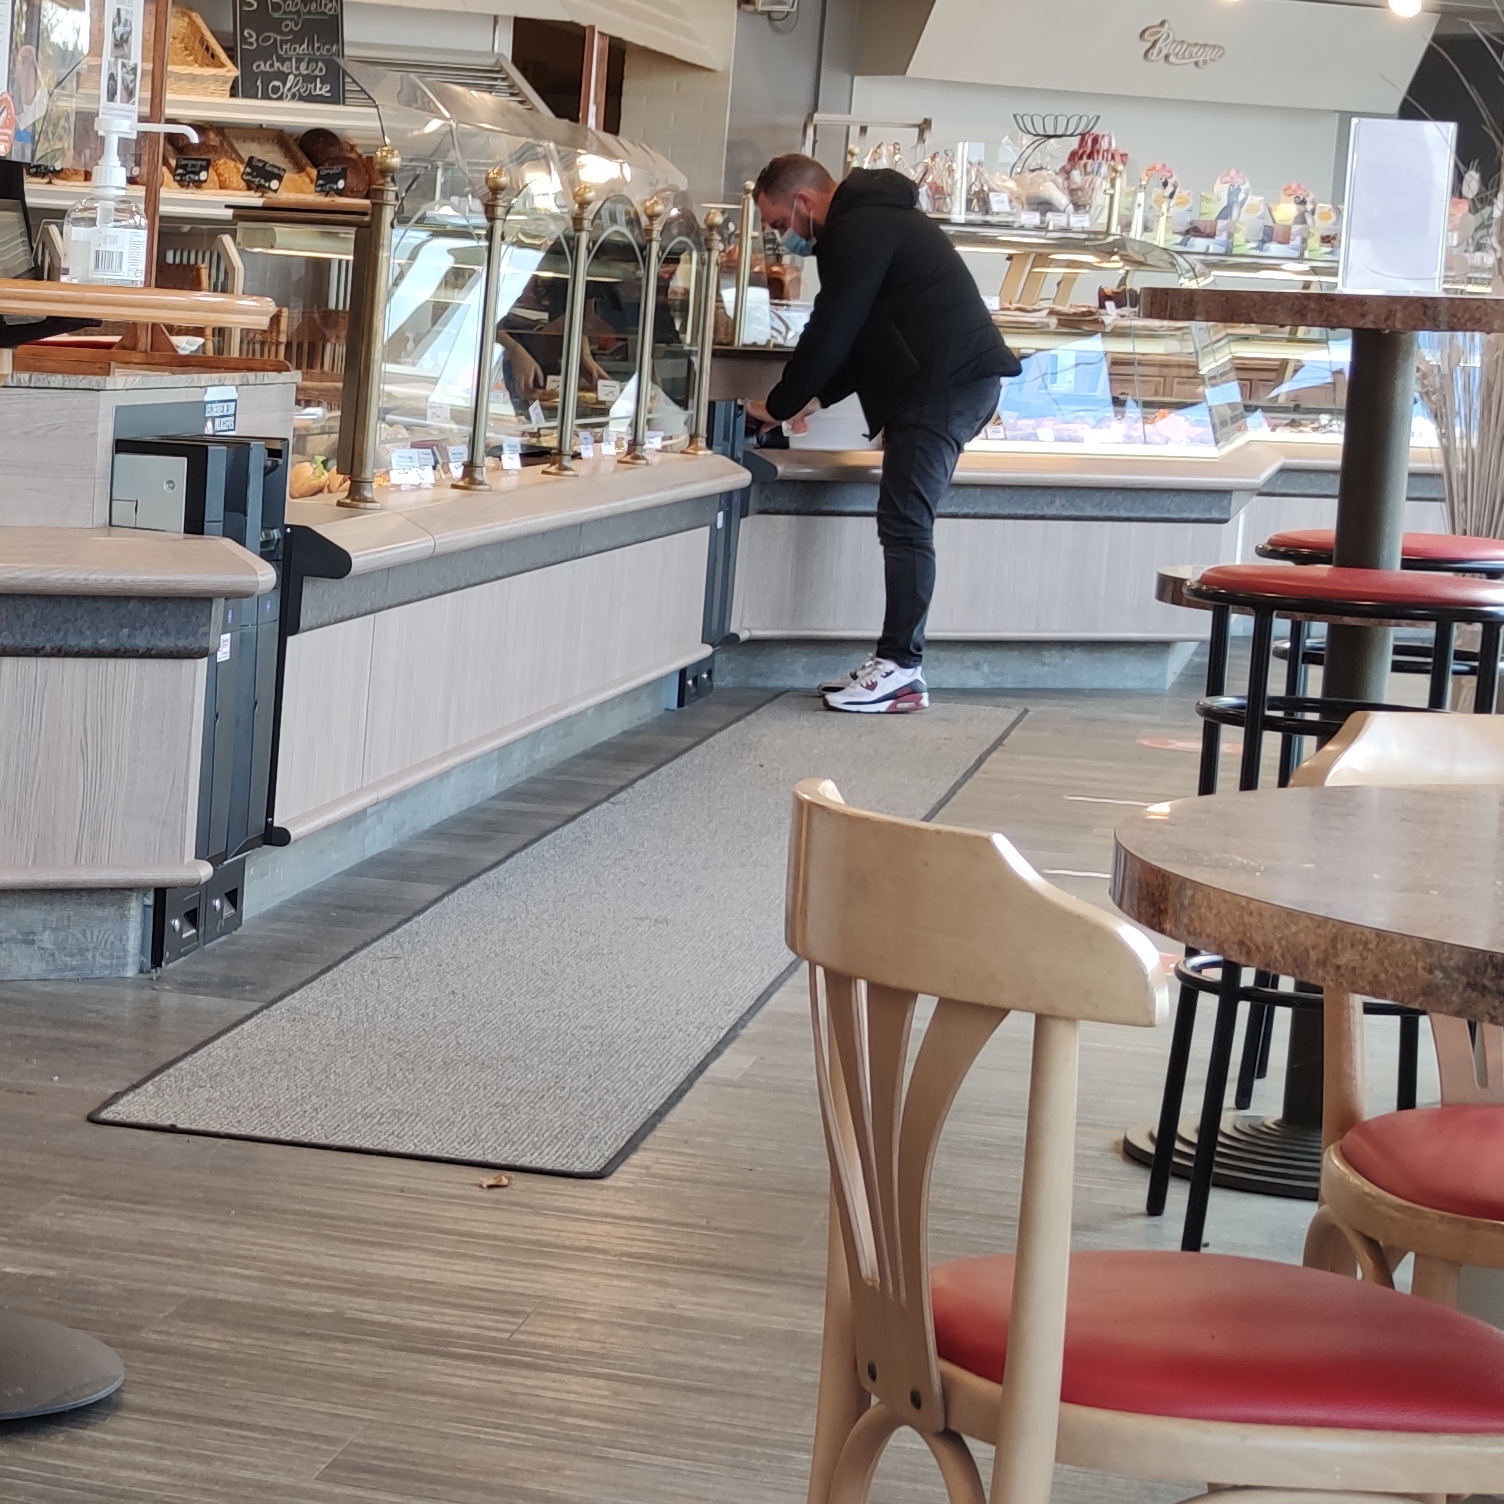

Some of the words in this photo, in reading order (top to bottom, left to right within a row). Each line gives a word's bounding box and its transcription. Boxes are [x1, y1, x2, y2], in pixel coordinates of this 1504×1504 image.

[242, 29, 257, 49] 3
[252, 53, 326, 76] achetées
[256, 76, 262, 98] 1
[268, 74, 332, 101] Offerte
